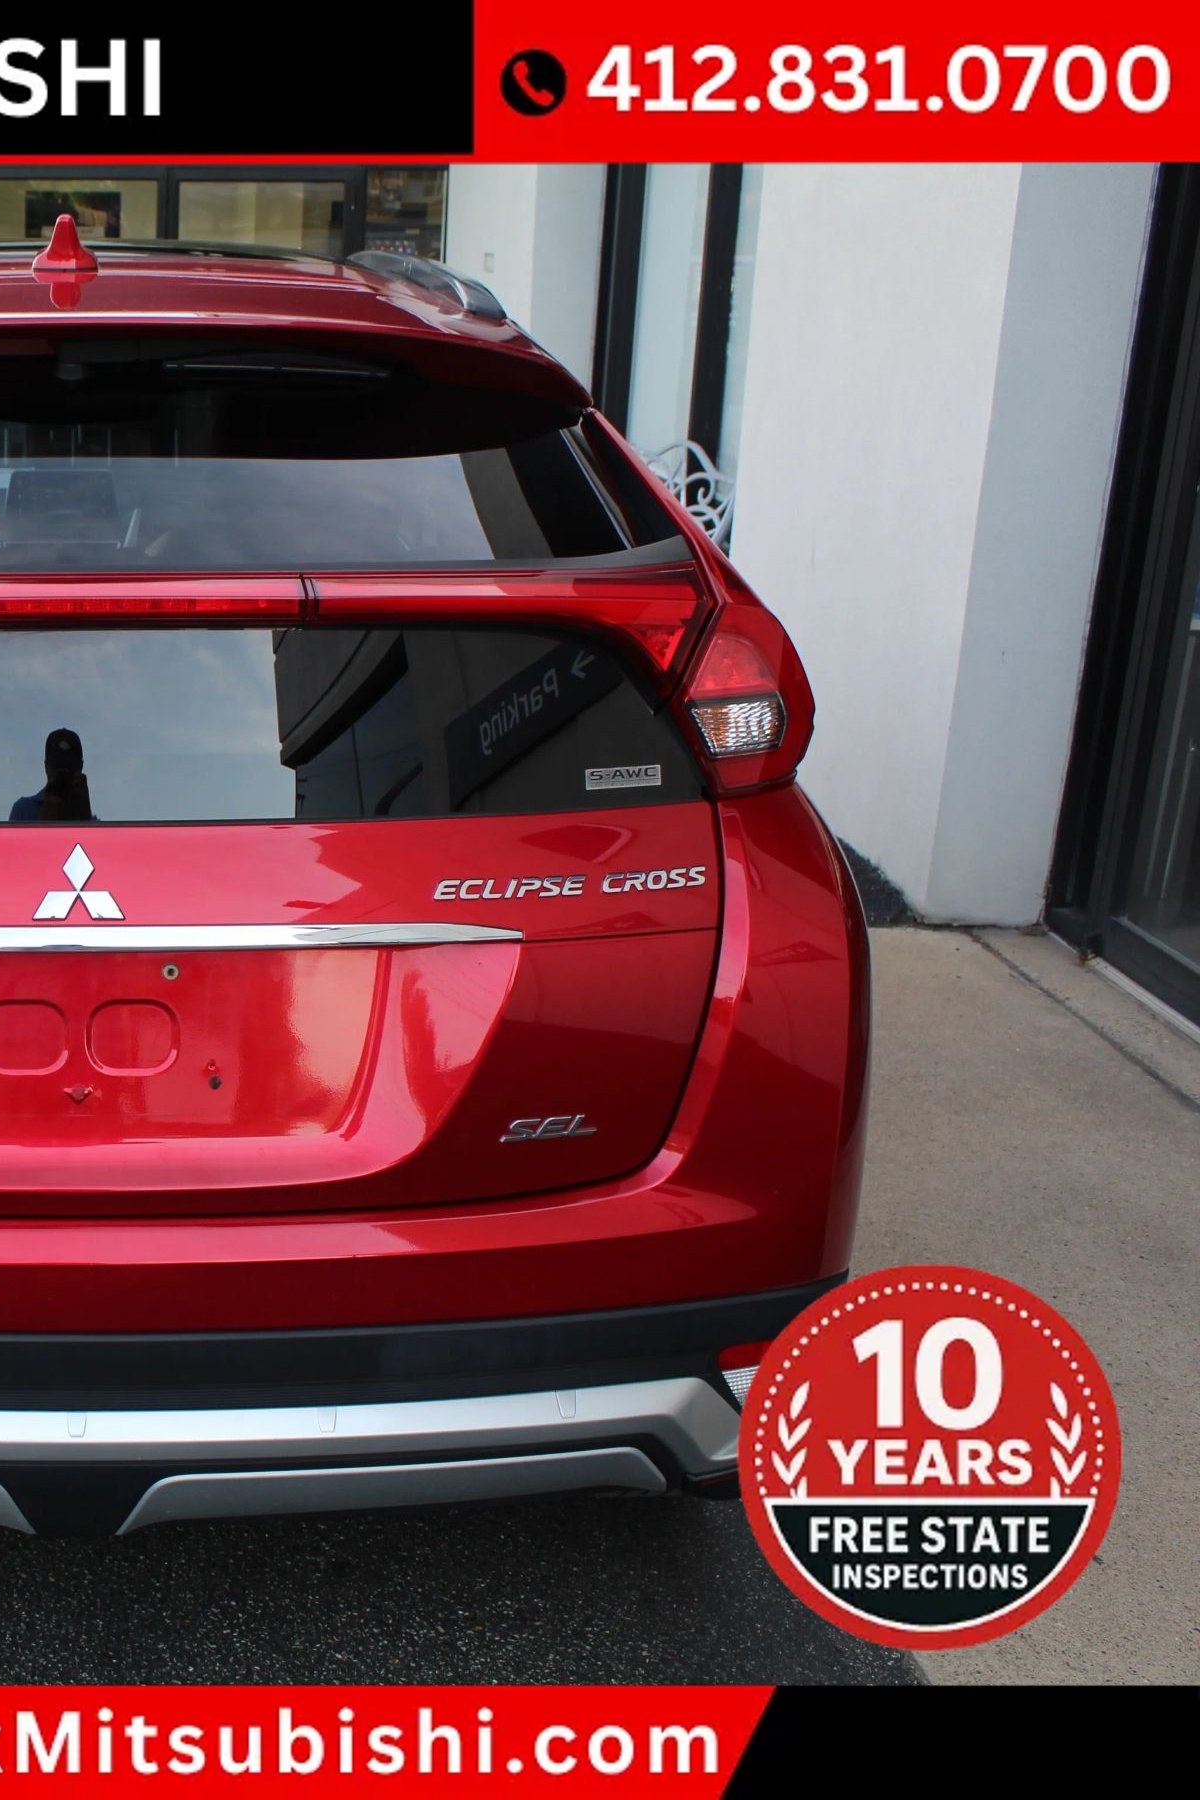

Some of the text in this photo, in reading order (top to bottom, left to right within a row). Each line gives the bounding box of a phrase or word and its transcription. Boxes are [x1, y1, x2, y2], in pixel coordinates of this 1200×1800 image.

[590, 766, 657, 782] S-AWC
[433, 866, 706, 901] ECLIPSE CROSS
[499, 1114, 598, 1143] SEL
